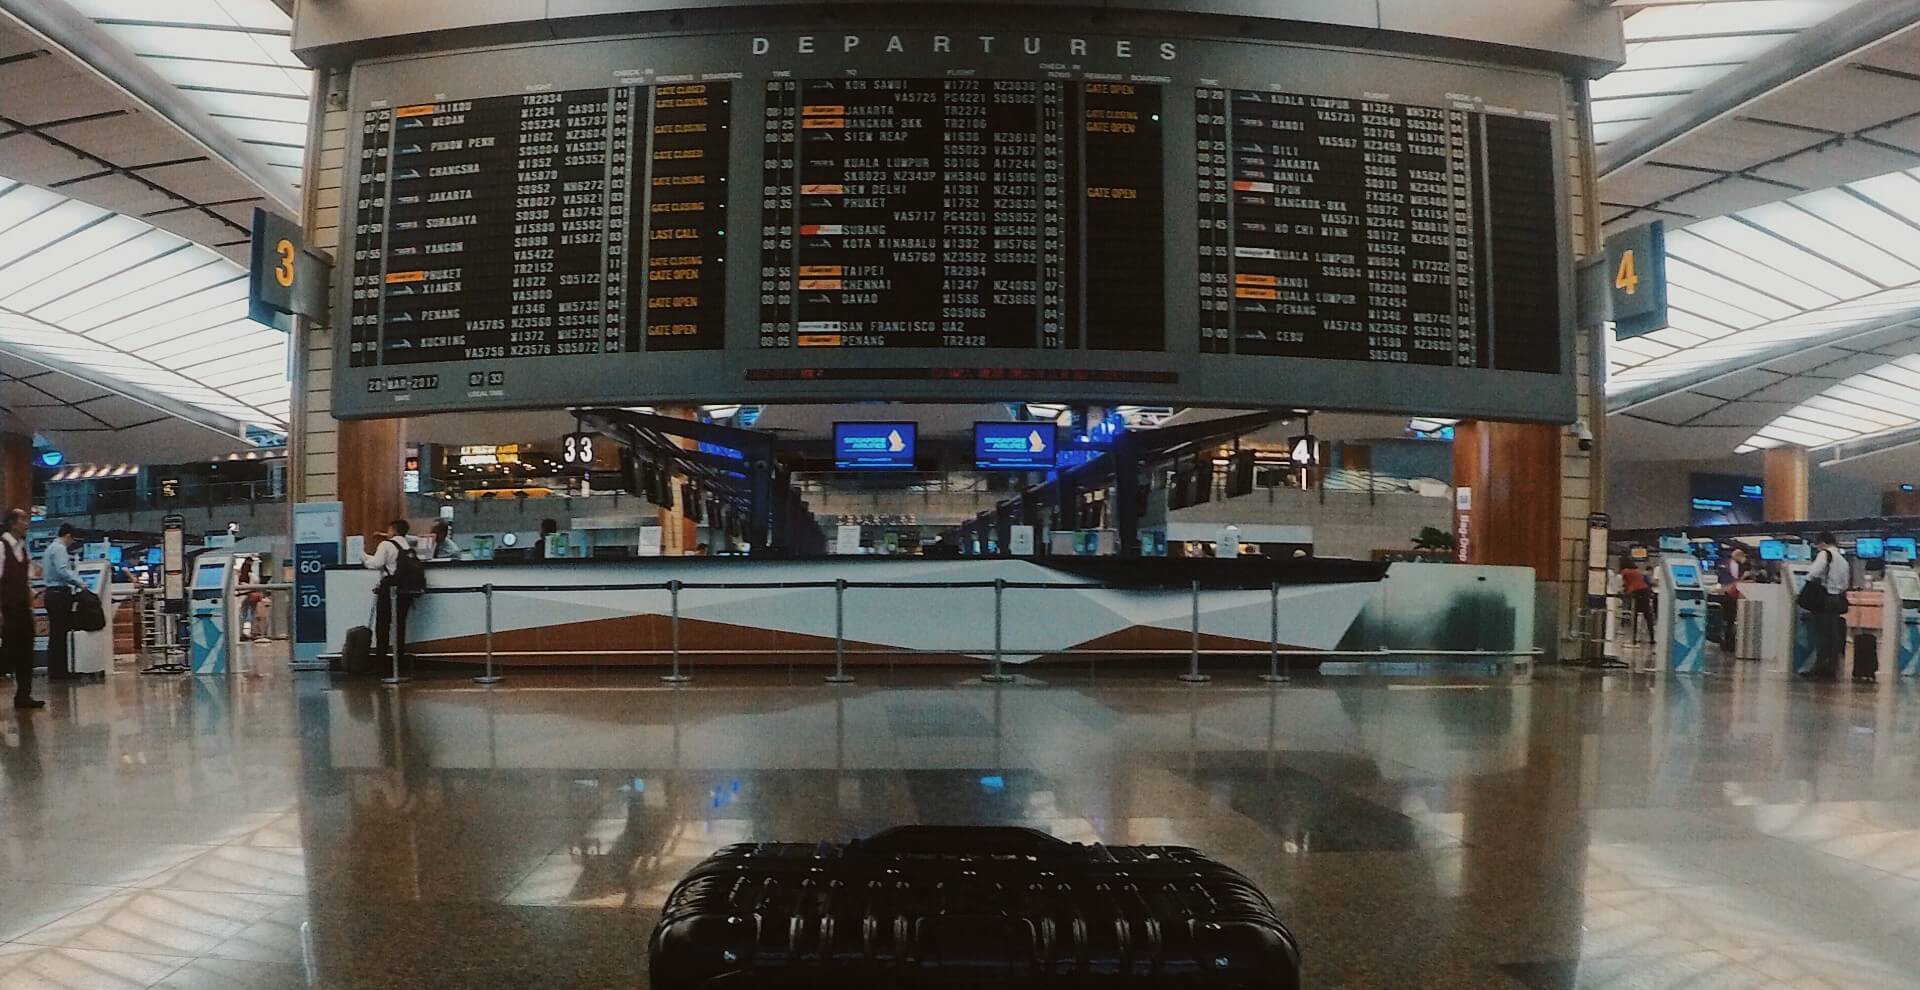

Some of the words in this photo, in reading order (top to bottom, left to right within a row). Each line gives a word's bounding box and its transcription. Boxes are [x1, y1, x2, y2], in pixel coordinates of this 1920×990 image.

[752, 35, 1177, 60] DEPARTURES
[1086, 84, 1108, 93] GATE
[1110, 85, 1134, 94] OPEN
[1272, 95, 1304, 105] KUALA
[844, 106, 893, 115] JAKARTA
[1086, 110, 1104, 118] GATE
[1087, 122, 1109, 132] GATE
[1111, 123, 1135, 133] OPEN
[1272, 120, 1303, 130] HANOI
[880, 132, 907, 141] REAP
[1273, 146, 1298, 155] DILI
[844, 159, 879, 167] KUALA
[887, 158, 929, 167] LUMPUR
[1274, 160, 1319, 169] JAKARTA
[653, 177, 671, 185] GATE
[1274, 172, 1313, 182] MANILA
[843, 185, 864, 194] NEW
[872, 185, 906, 194] DELHI
[1088, 188, 1110, 197] GATE
[1111, 189, 1136, 198] OPEN
[428, 190, 472, 203] JAKARTA
[844, 198, 885, 207] PHUKET
[652, 204, 670, 212] GATE
[894, 212, 936, 220] VA5717
[426, 216, 476, 227] SURABAYA
[651, 230, 673, 239] LAST
[675, 229, 698, 238] CALL
[840, 225, 885, 234] SUBANG
[1295, 225, 1313, 234] CHI
[426, 243, 462, 253] YANGON
[843, 239, 871, 248] KOTA
[879, 239, 936, 248] KINABALU
[274, 239, 295, 287] 3
[650, 258, 668, 266] GATE
[669, 256, 702, 265] CLOSING
[650, 270, 672, 280] GATE
[673, 269, 698, 279] OPEN
[842, 266, 883, 275] TAIPEI
[1615, 249, 1638, 296] 4
[841, 280, 890, 290] CHENNAI
[842, 294, 877, 303] DAVAO
[1275, 291, 1309, 301] KUALA
[649, 298, 671, 307] GATE
[673, 297, 697, 307] OPEN
[1277, 304, 1316, 314] PENANG
[422, 310, 459, 320] PENANG
[648, 325, 670, 335] GATE
[672, 325, 696, 334] OPEN
[840, 322, 862, 331] SAN
[871, 322, 935, 331] FRANCISCO
[840, 336, 884, 345] PENANG
[1277, 332, 1303, 341] CEBU
